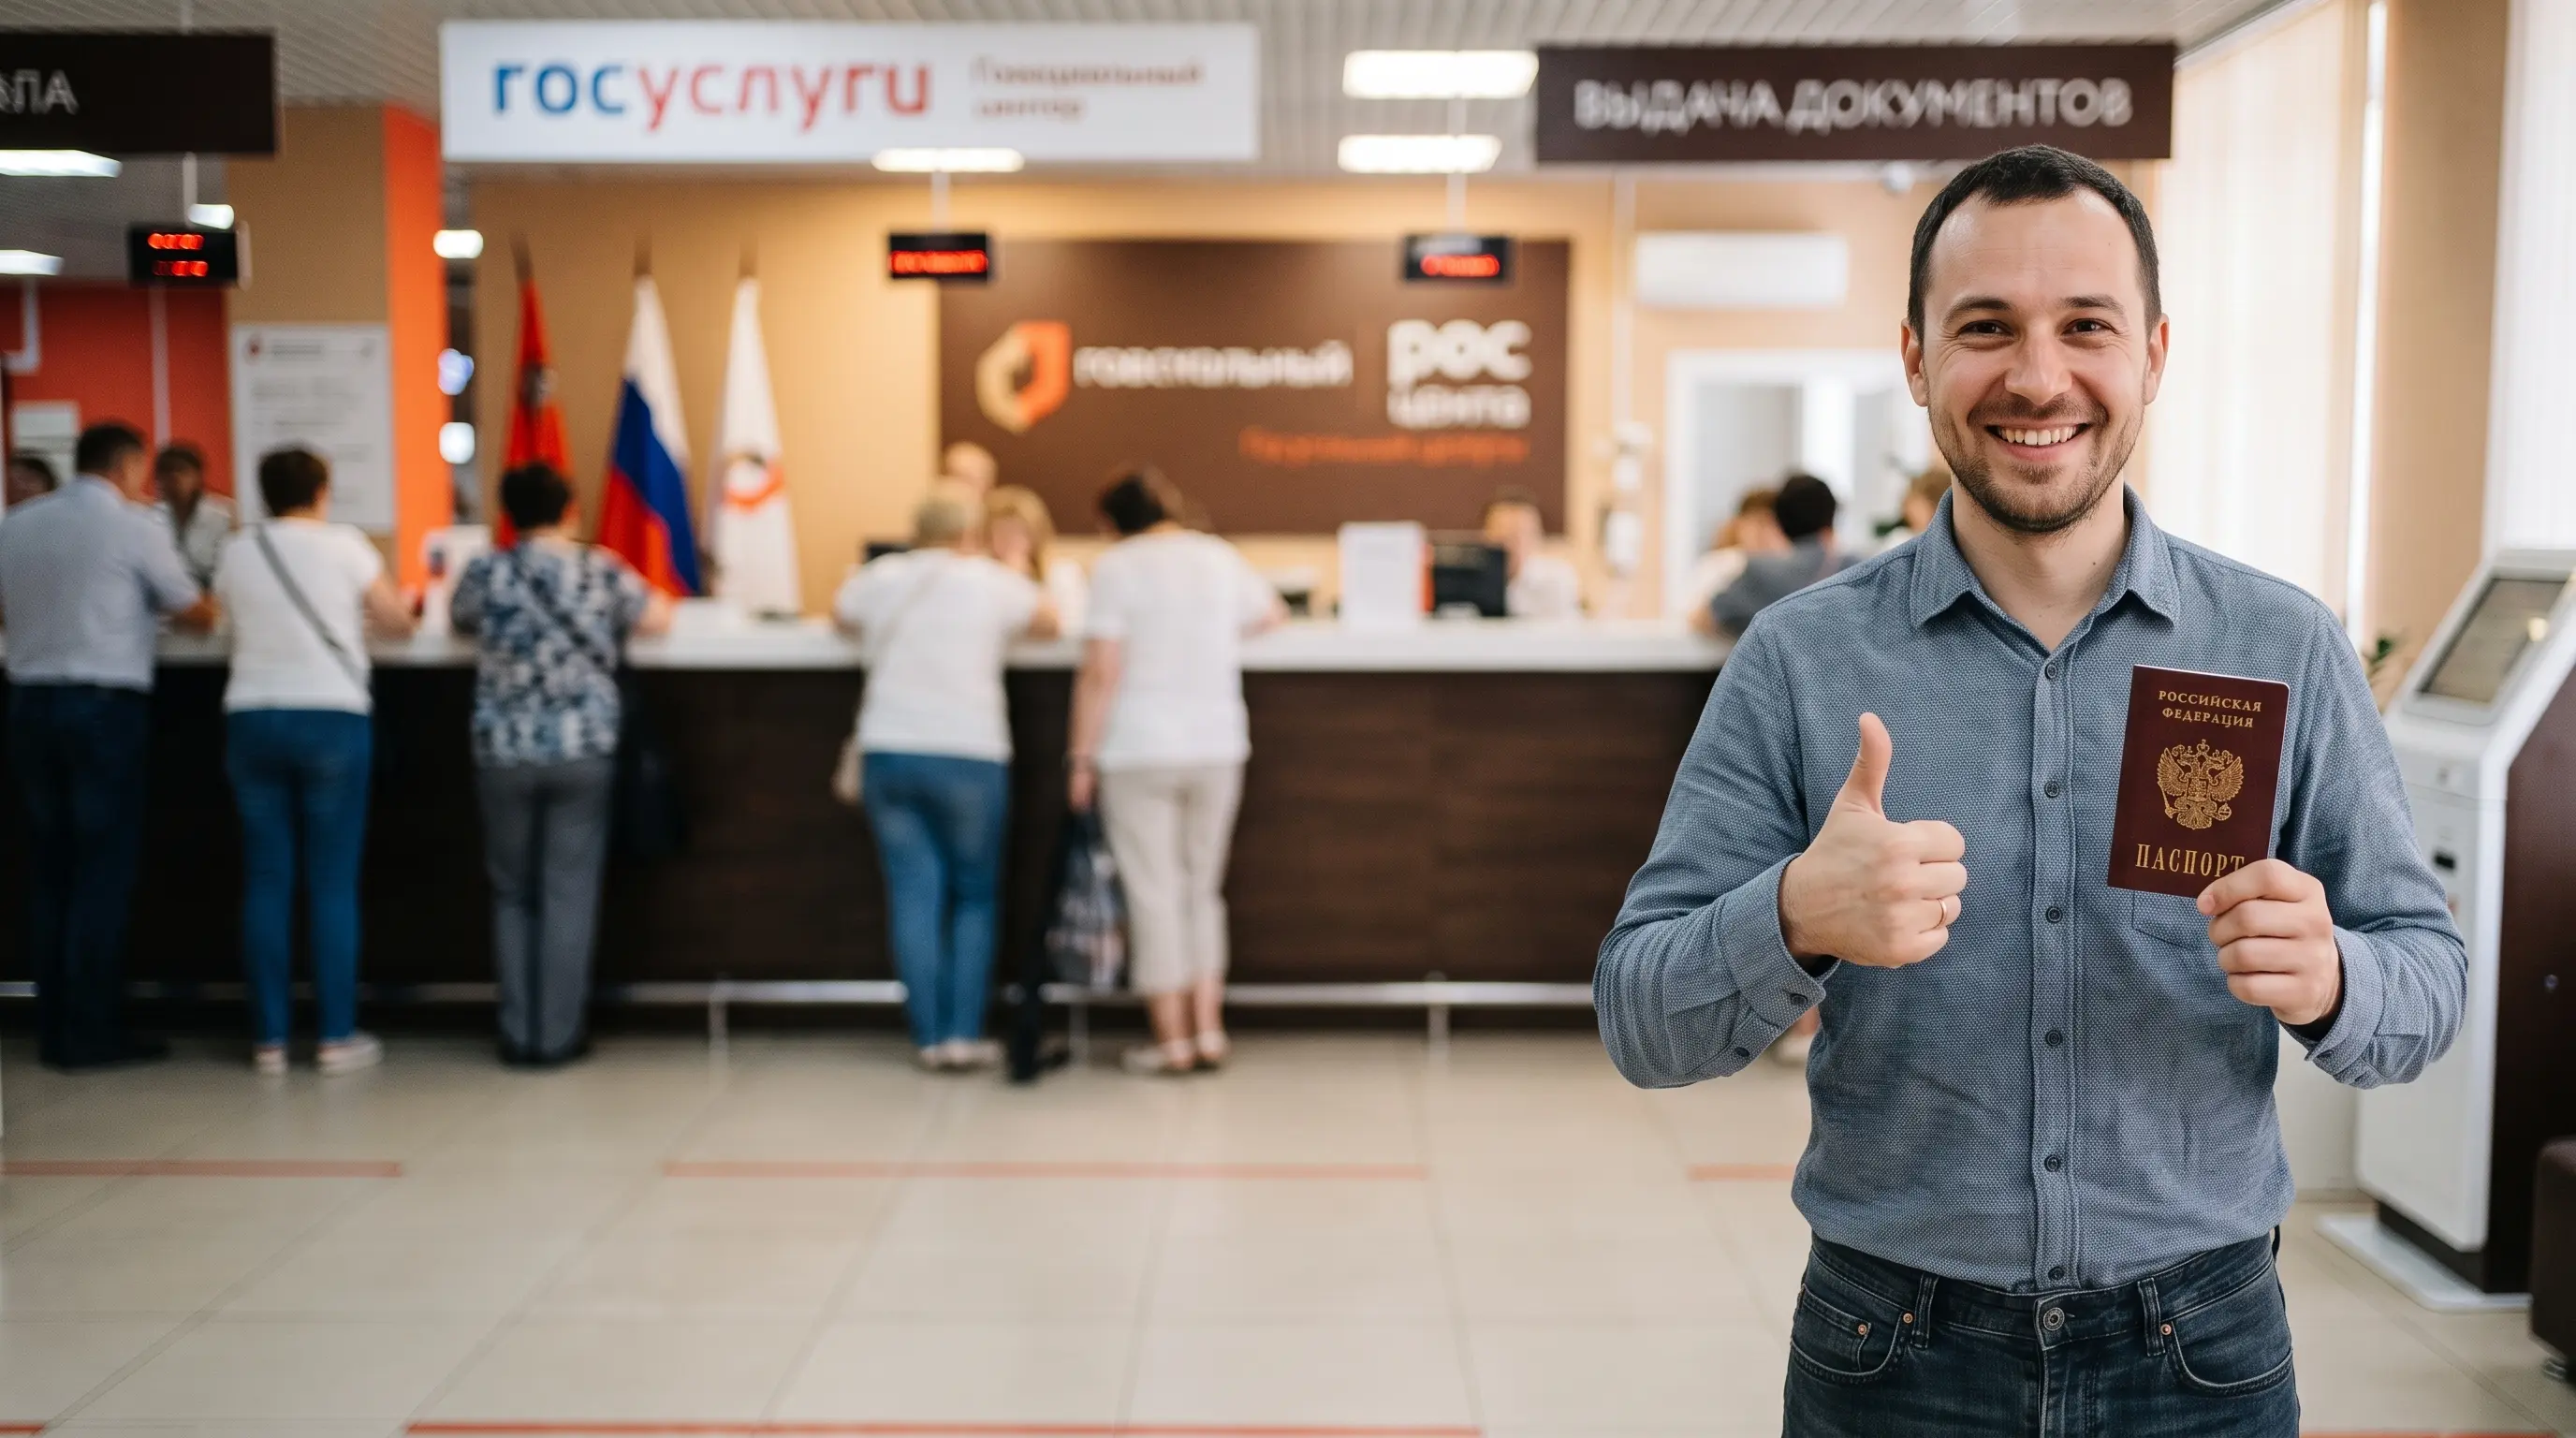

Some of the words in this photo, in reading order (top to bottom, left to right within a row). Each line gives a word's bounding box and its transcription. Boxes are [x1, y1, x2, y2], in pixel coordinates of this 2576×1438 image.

[1574, 79, 1784, 138] ВЫДАЧА
[1784, 78, 2133, 137] ДОКУМЕНТОВ
[2158, 690, 2262, 712] РОССИЙСКАЯ
[2161, 707, 2254, 728] ФЕДЕРАЦИЯ
[2135, 844, 2245, 877] ПАСПОРТ
